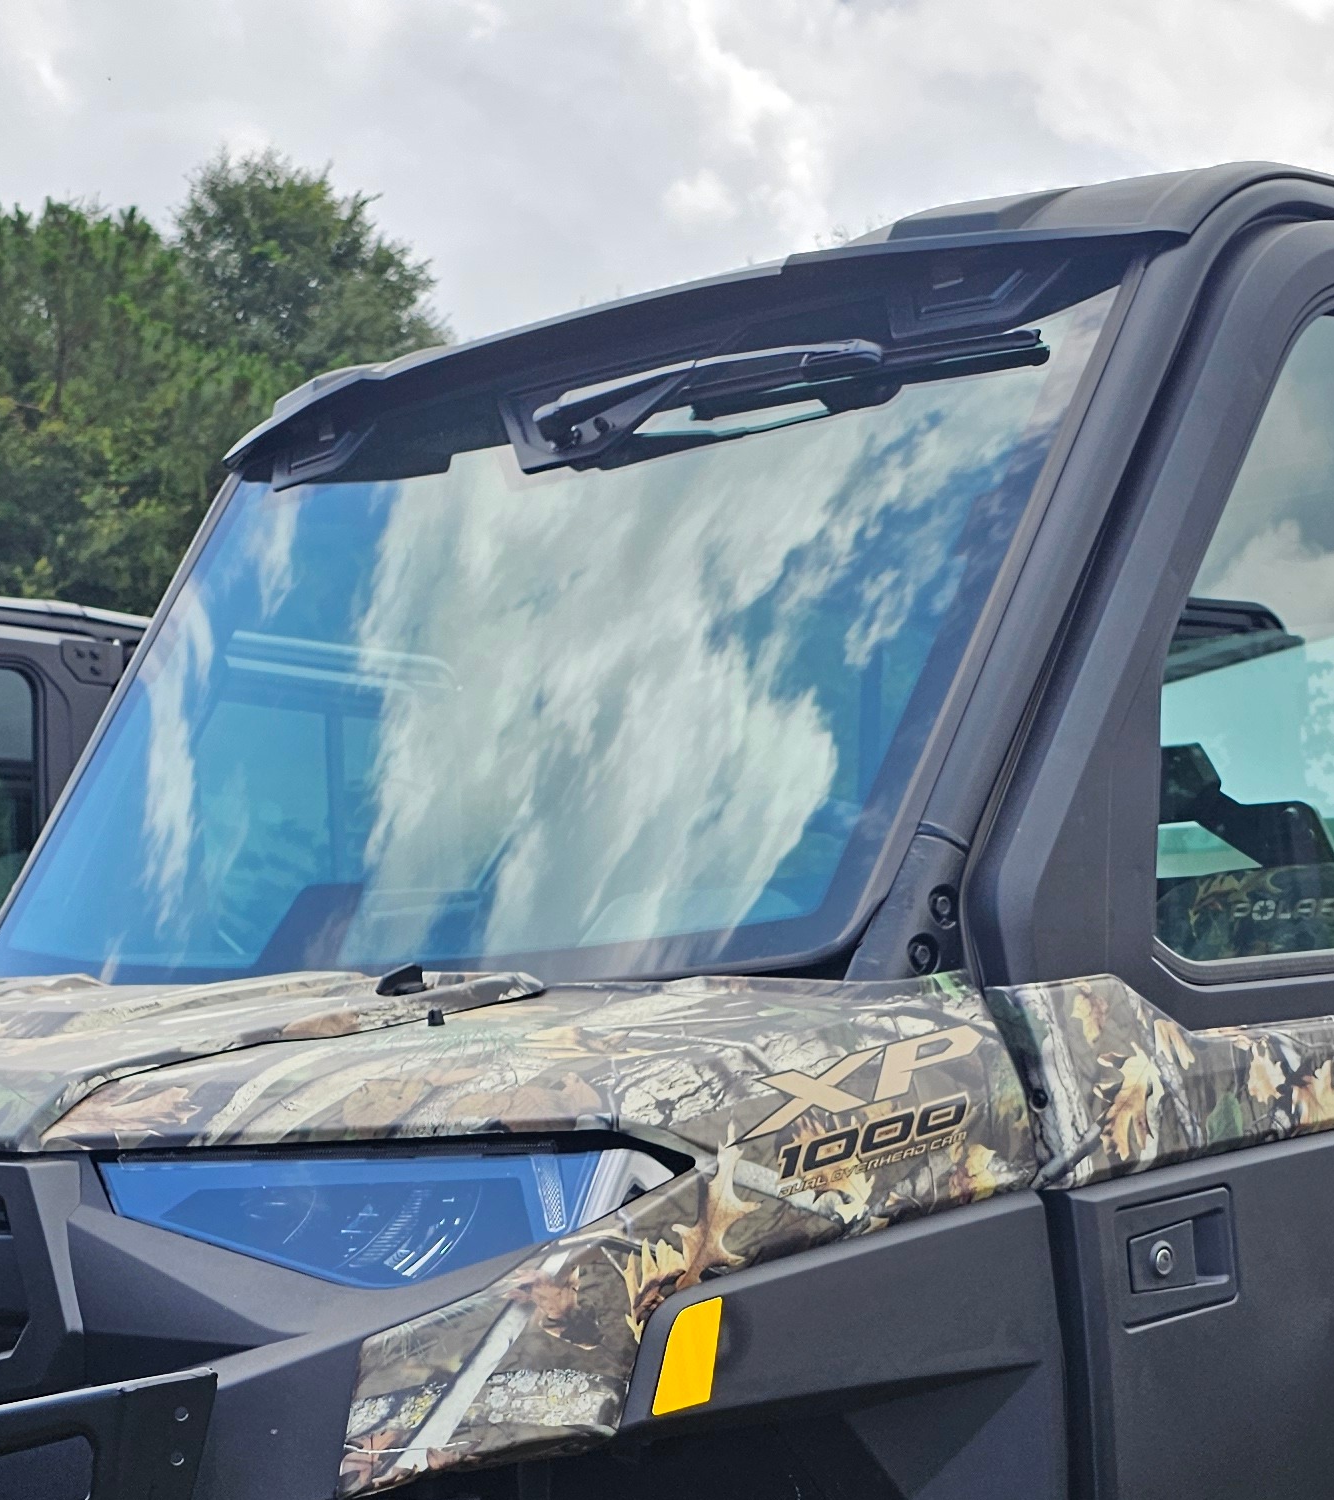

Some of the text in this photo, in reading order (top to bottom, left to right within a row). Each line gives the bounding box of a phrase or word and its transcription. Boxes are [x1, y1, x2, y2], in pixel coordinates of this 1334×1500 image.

[727, 1024, 984, 1146] XP
[777, 1092, 970, 1184] 1000
[779, 1131, 968, 1199] DUAL OVERHEAD CAM
